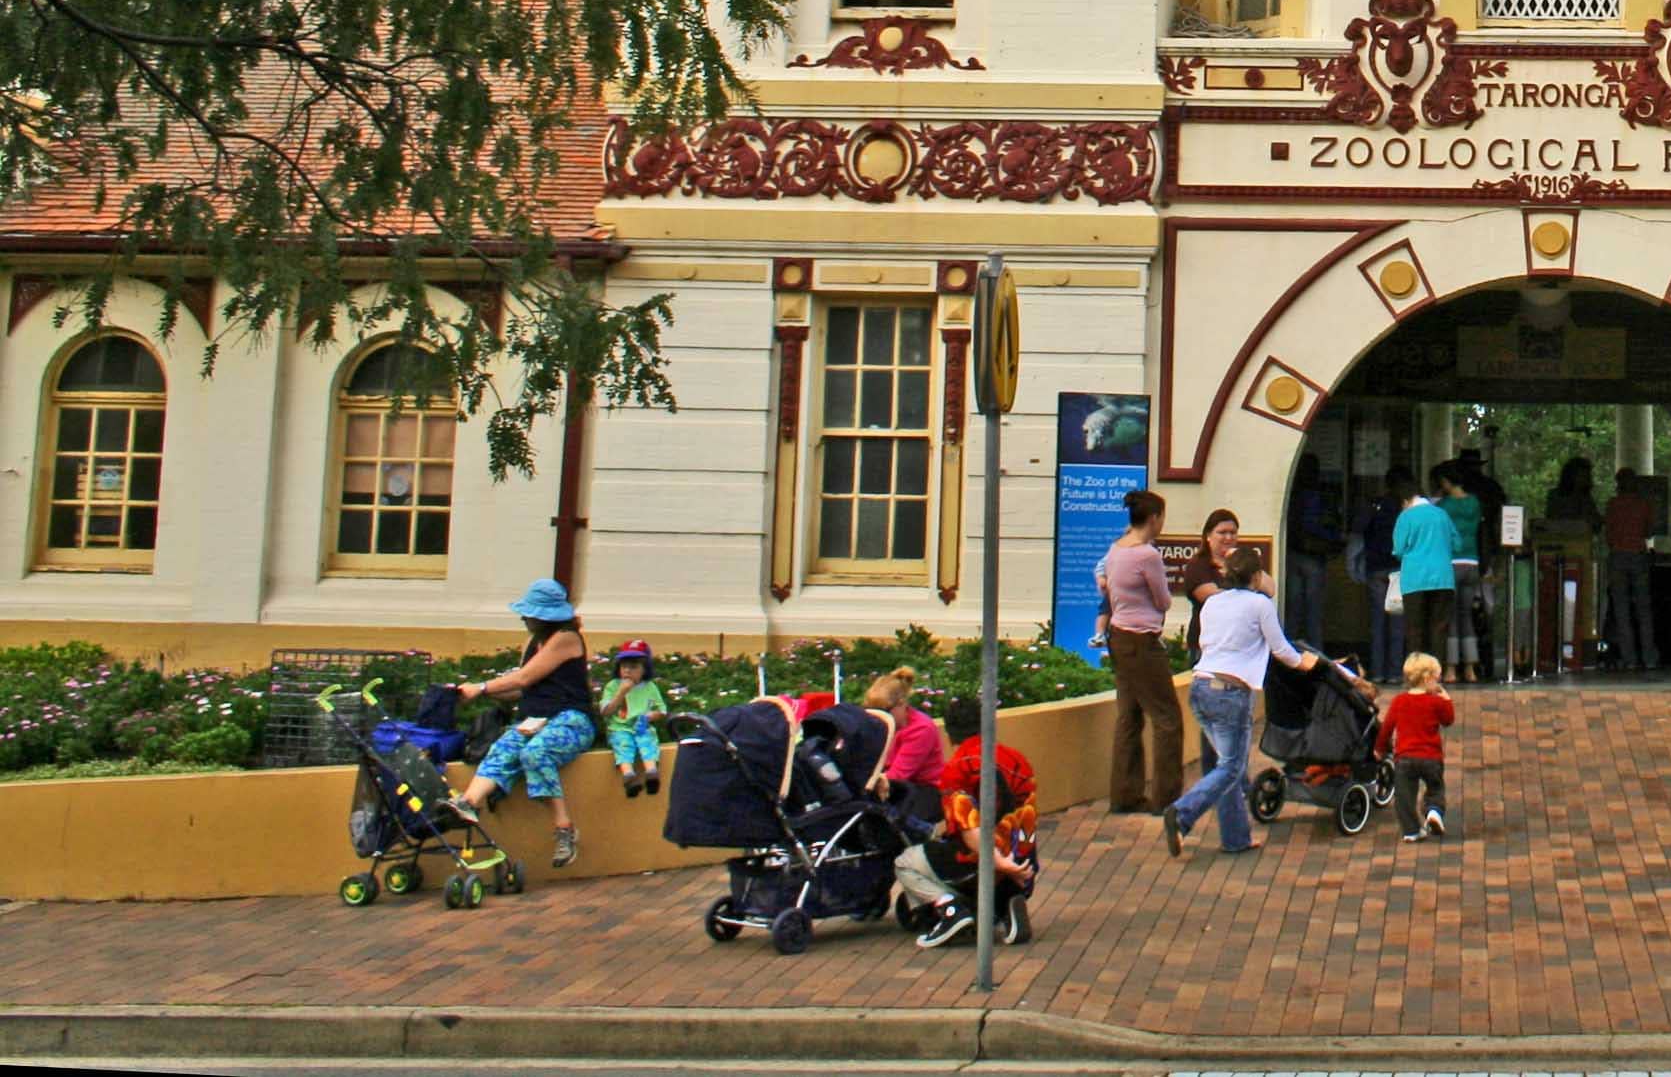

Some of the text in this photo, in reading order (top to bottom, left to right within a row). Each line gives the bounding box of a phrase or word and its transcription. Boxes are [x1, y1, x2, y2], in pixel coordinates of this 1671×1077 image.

[1478, 83, 1626, 108] TARONGA
[1310, 137, 1640, 172] ZOOLOGICAL
[1533, 175, 1570, 195] 1916
[1063, 475, 1137, 487] The Zoo of the
[1062, 488, 1096, 499] Future
[1097, 489, 1106, 499] is
